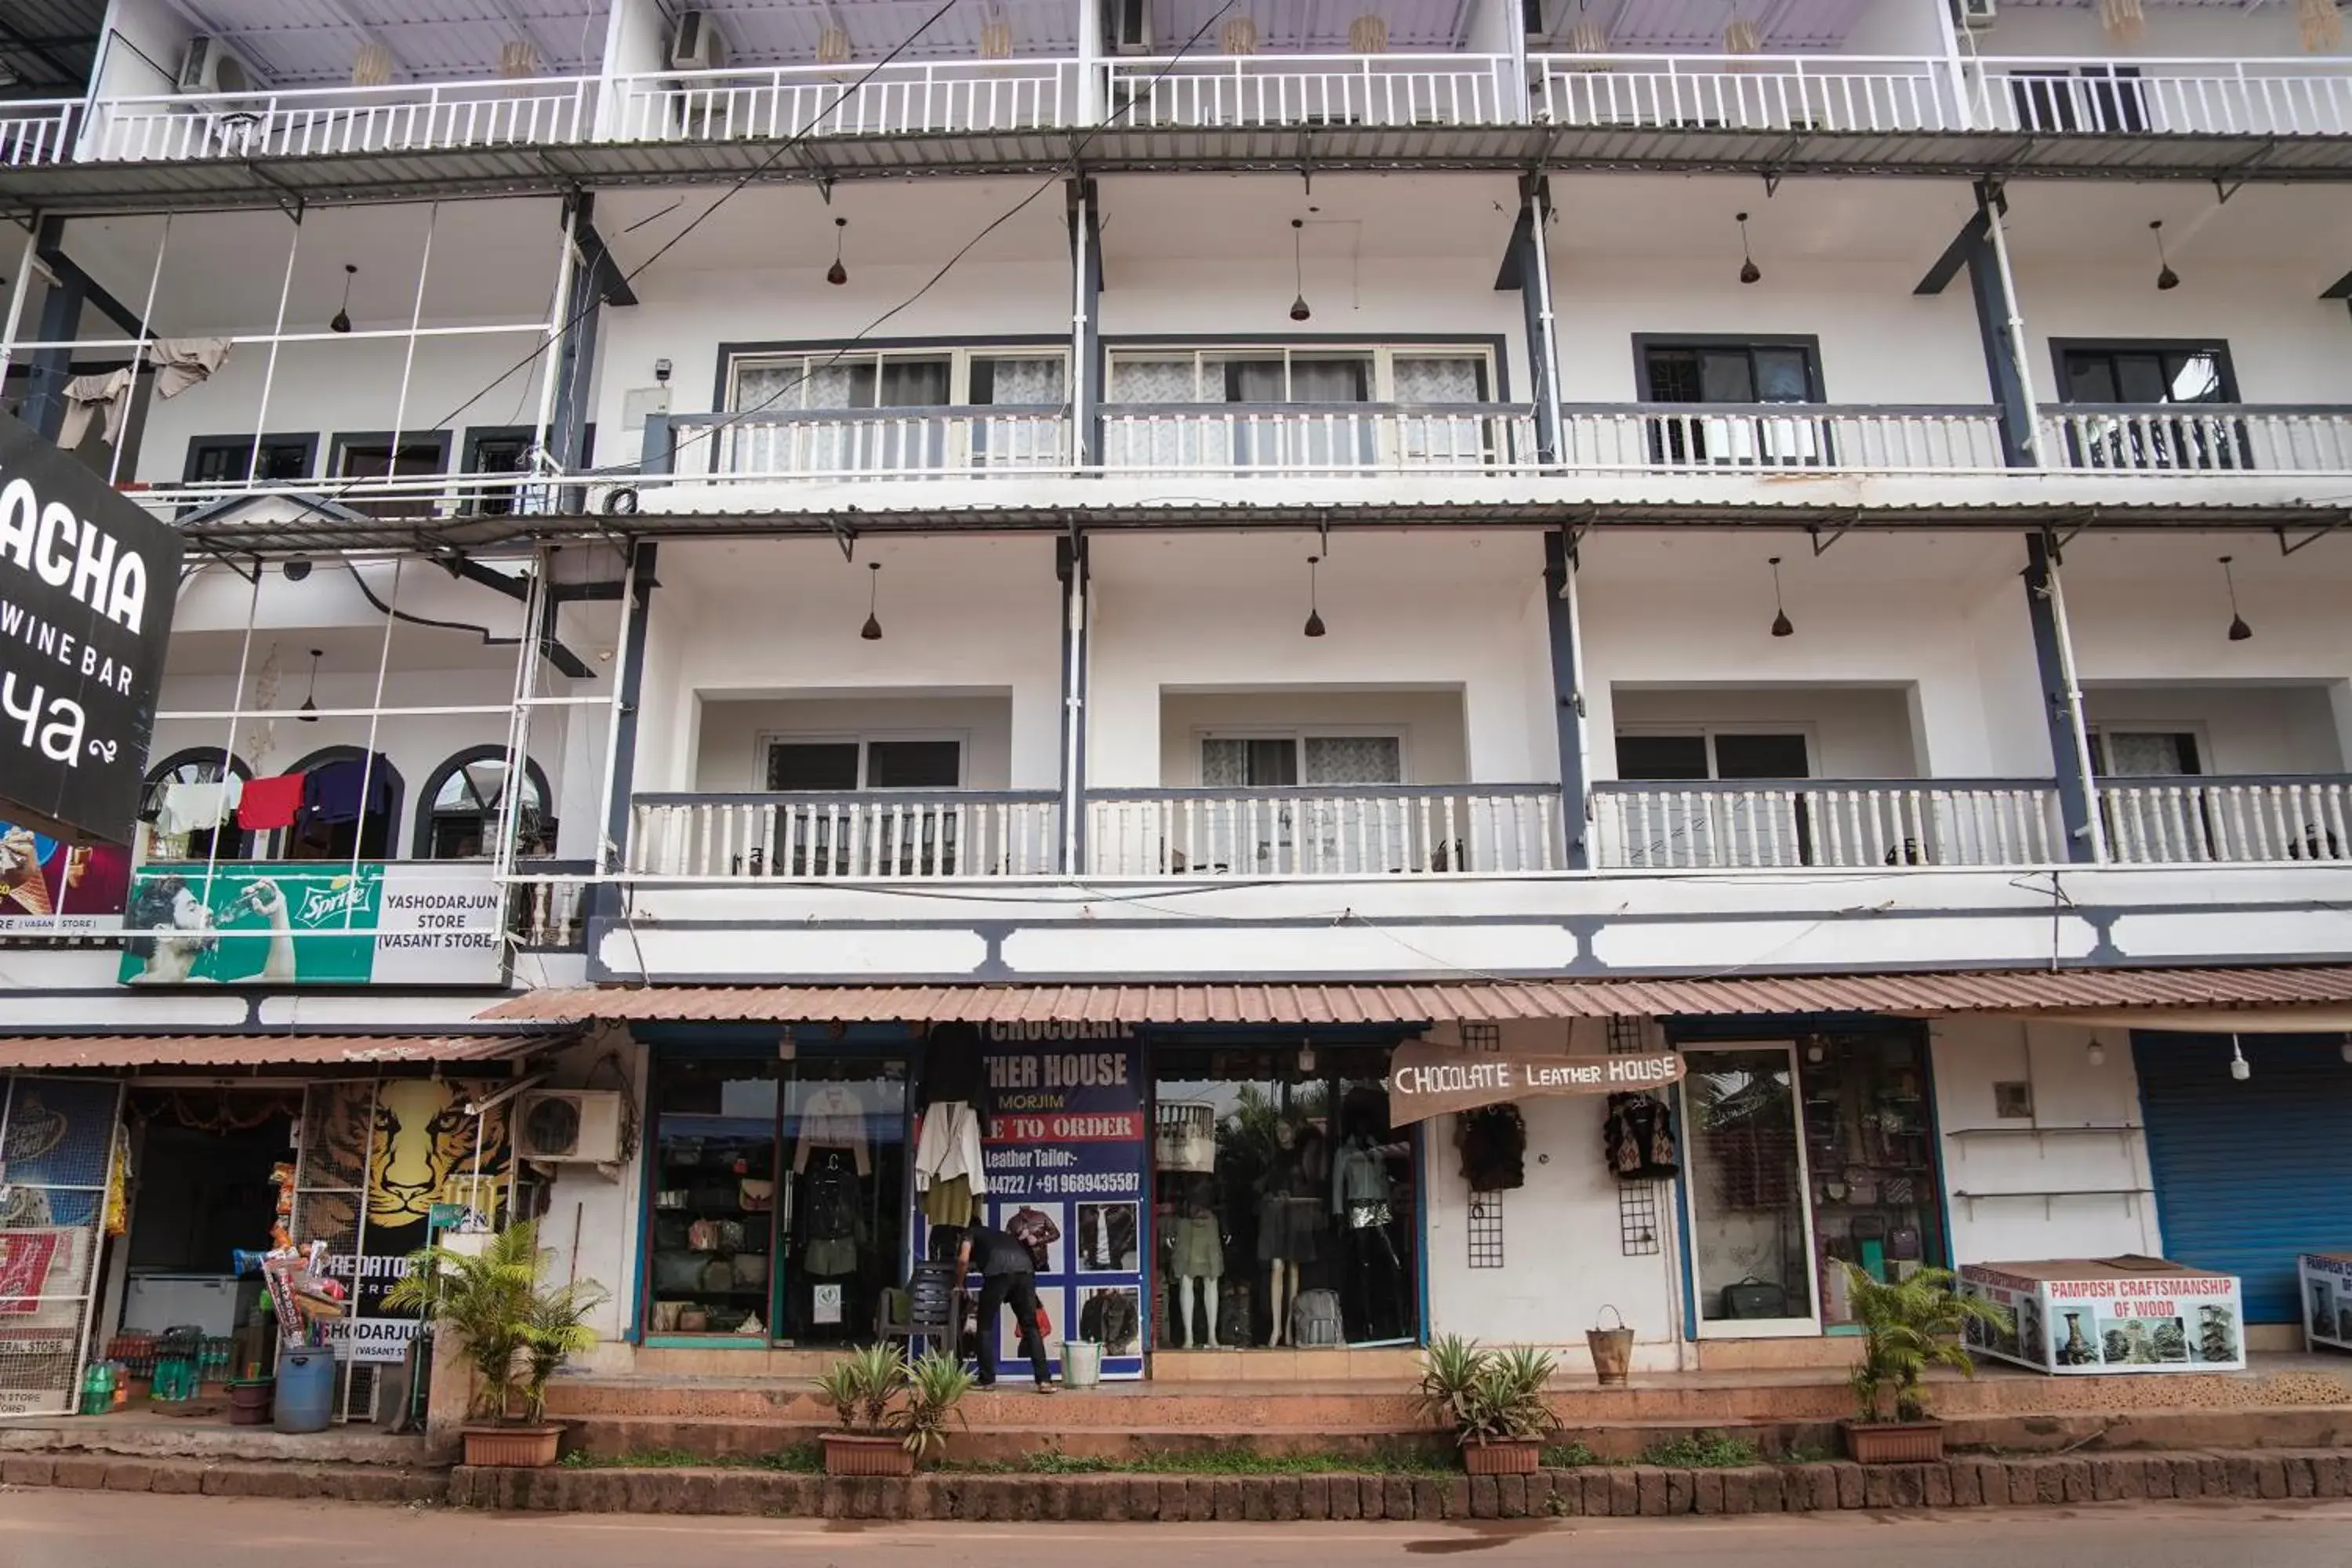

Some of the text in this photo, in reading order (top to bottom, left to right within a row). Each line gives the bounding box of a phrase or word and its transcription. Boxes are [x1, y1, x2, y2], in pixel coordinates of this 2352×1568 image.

[2, 601, 132, 696] WINE BAR
[387, 896, 498, 909] YASHODARJUN
[418, 915, 466, 927] STORE
[1044, 1054, 1127, 1086] HOUSE
[1396, 1063, 1510, 1094] CHOCOLATE
[1609, 1057, 1676, 1081] HOUSE
[999, 1094, 1065, 1110] MORJIM
[1013, 1118, 1045, 1138] TO
[1054, 1116, 1133, 1137] ORDER
[985, 1149, 1033, 1168] Leather
[1036, 1176, 1058, 1193] +91
[1061, 1173, 1140, 1192] 9689435587
[2051, 1279, 2232, 1298] PAMPOSH CRAFTSMANSHIP
[2114, 1301, 2175, 1317] OF WOOD
[28, 1341, 63, 1352] STORE
